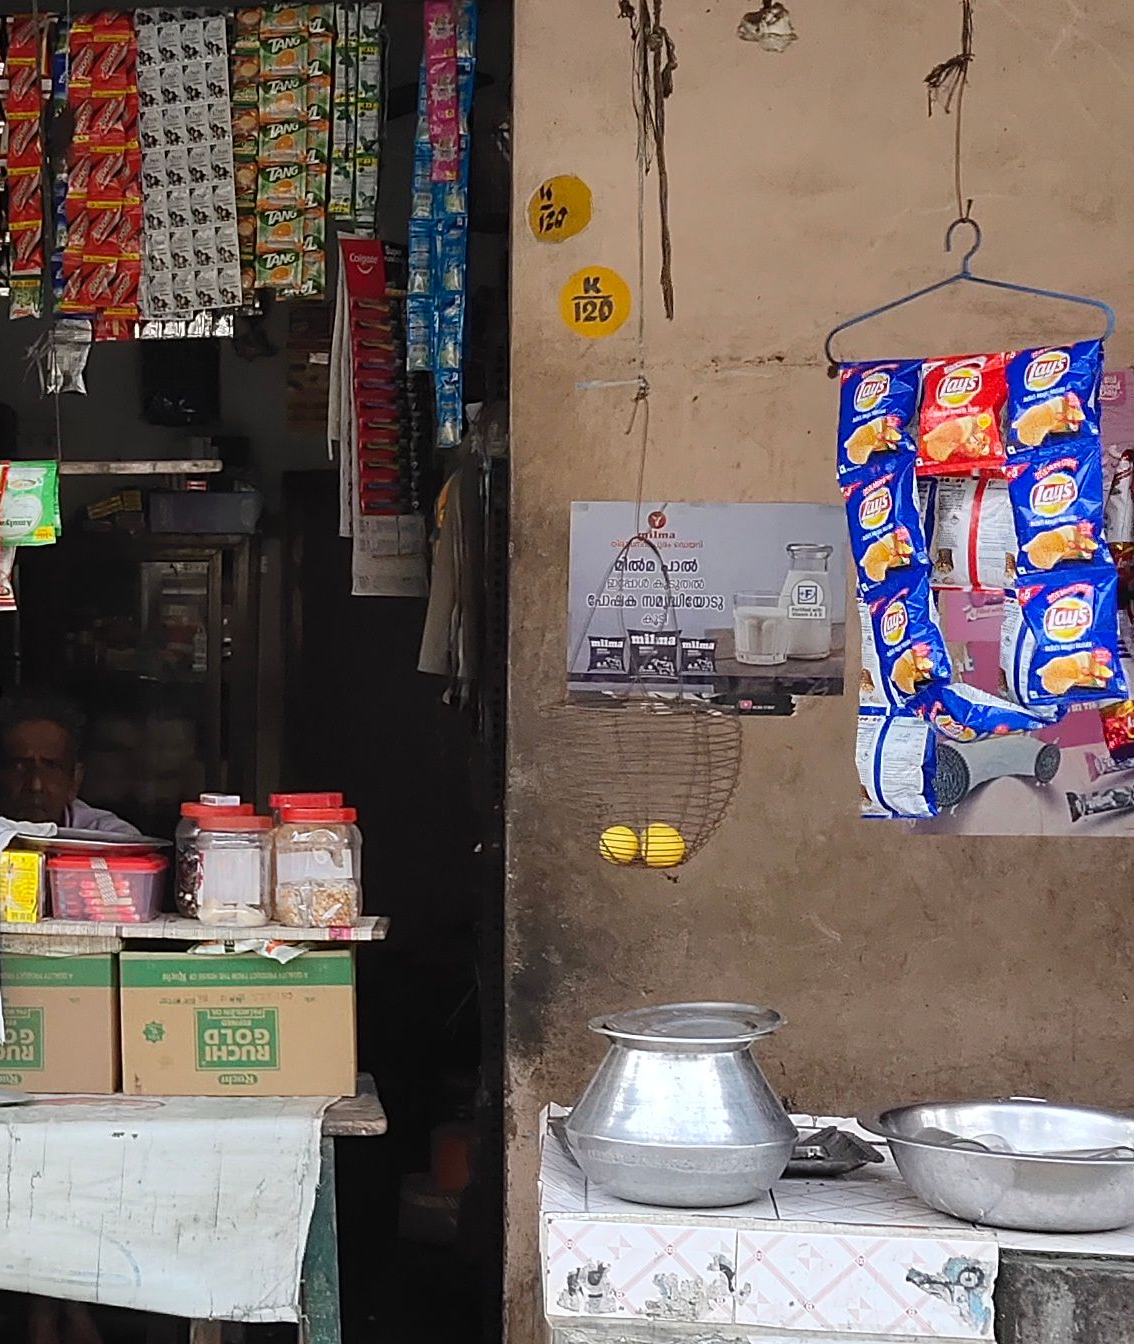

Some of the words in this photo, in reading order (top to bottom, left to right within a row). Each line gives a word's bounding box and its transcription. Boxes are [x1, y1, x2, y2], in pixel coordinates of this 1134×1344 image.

[268, 37, 300, 53] TANG
[267, 78, 299, 94] TANG
[266, 122, 299, 138] TANG
[266, 165, 298, 181] TANG
[264, 210, 297, 225] TANG
[262, 253, 295, 269] TANG
[349, 253, 378, 265] Colgate
[583, 276, 602, 294] K
[574, 298, 614, 322] 120
[615, 557, 655, 572] മിൽമ
[591, 640, 623, 648] milma
[631, 634, 676, 645] milma
[682, 641, 715, 650] milma
[203, 1028, 270, 1044] GOLD
[204, 1046, 270, 1061] RUCHI
[221, 1074, 254, 1085] Ruchi
